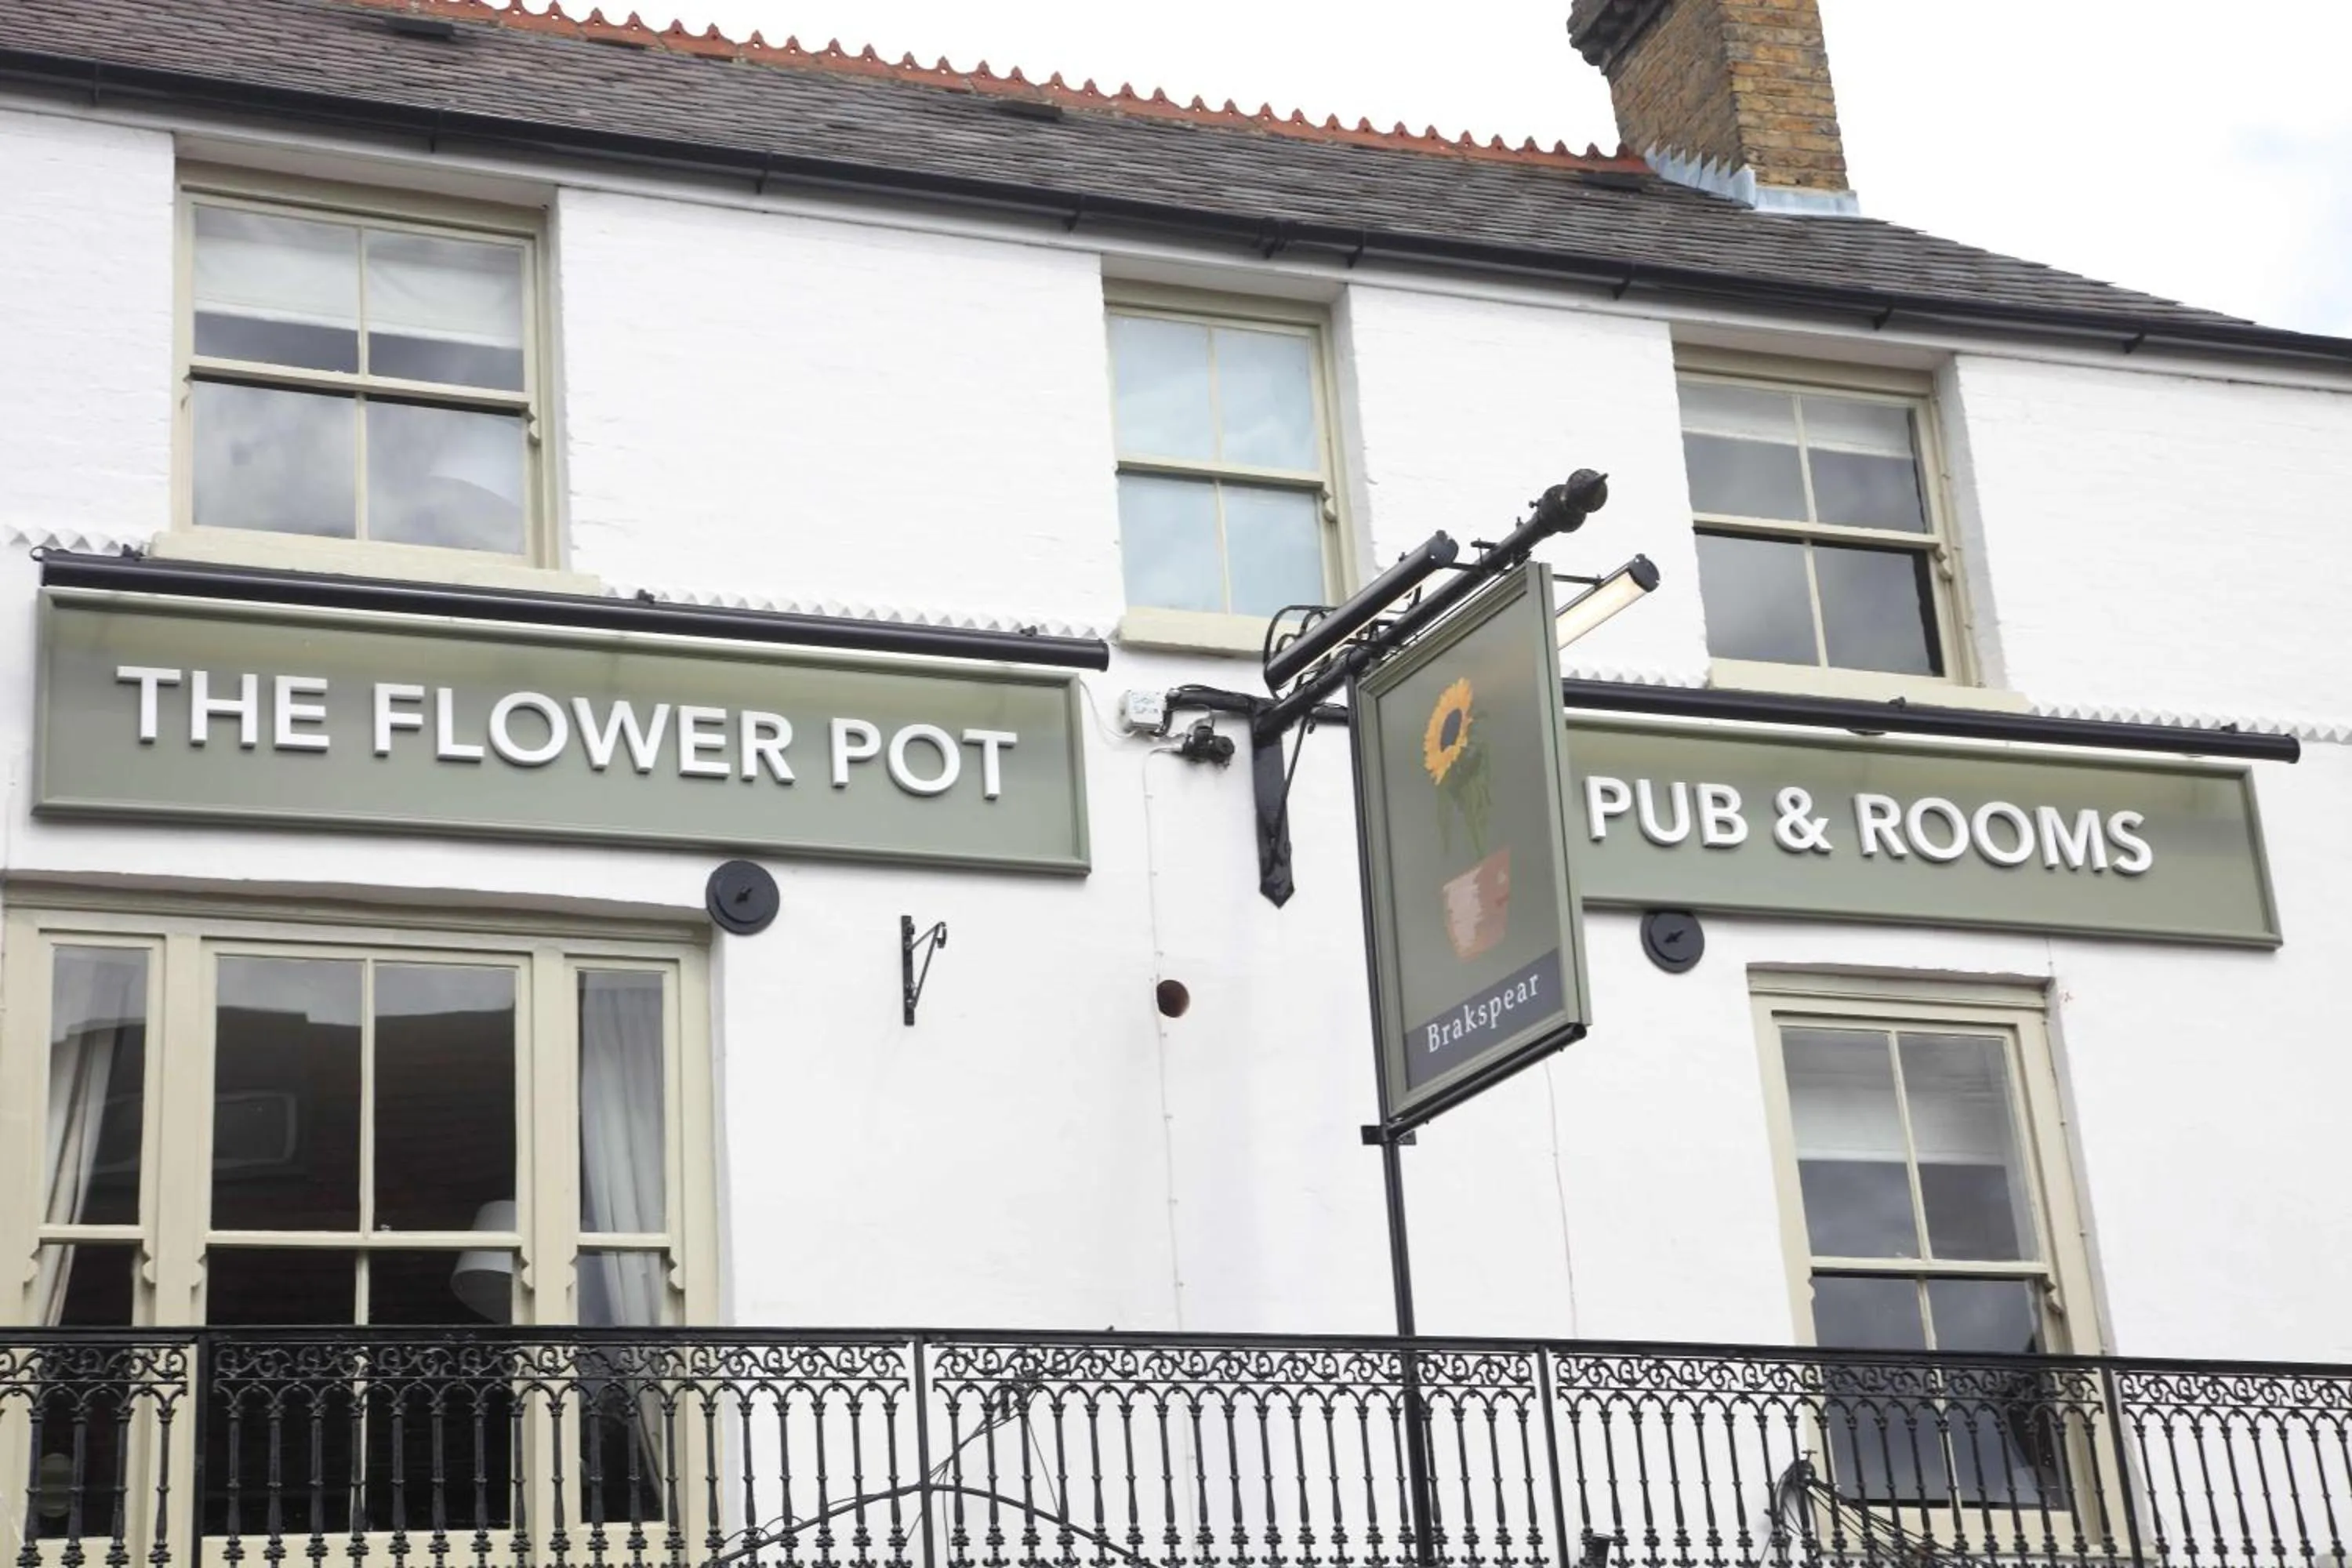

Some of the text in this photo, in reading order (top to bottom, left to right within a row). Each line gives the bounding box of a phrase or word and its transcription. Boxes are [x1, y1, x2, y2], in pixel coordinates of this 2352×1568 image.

[116, 666, 1018, 800] THE FLOWER POT
[1585, 775, 2154, 877] PUB & ROOMS
[1425, 974, 1540, 1053] Brakspear
